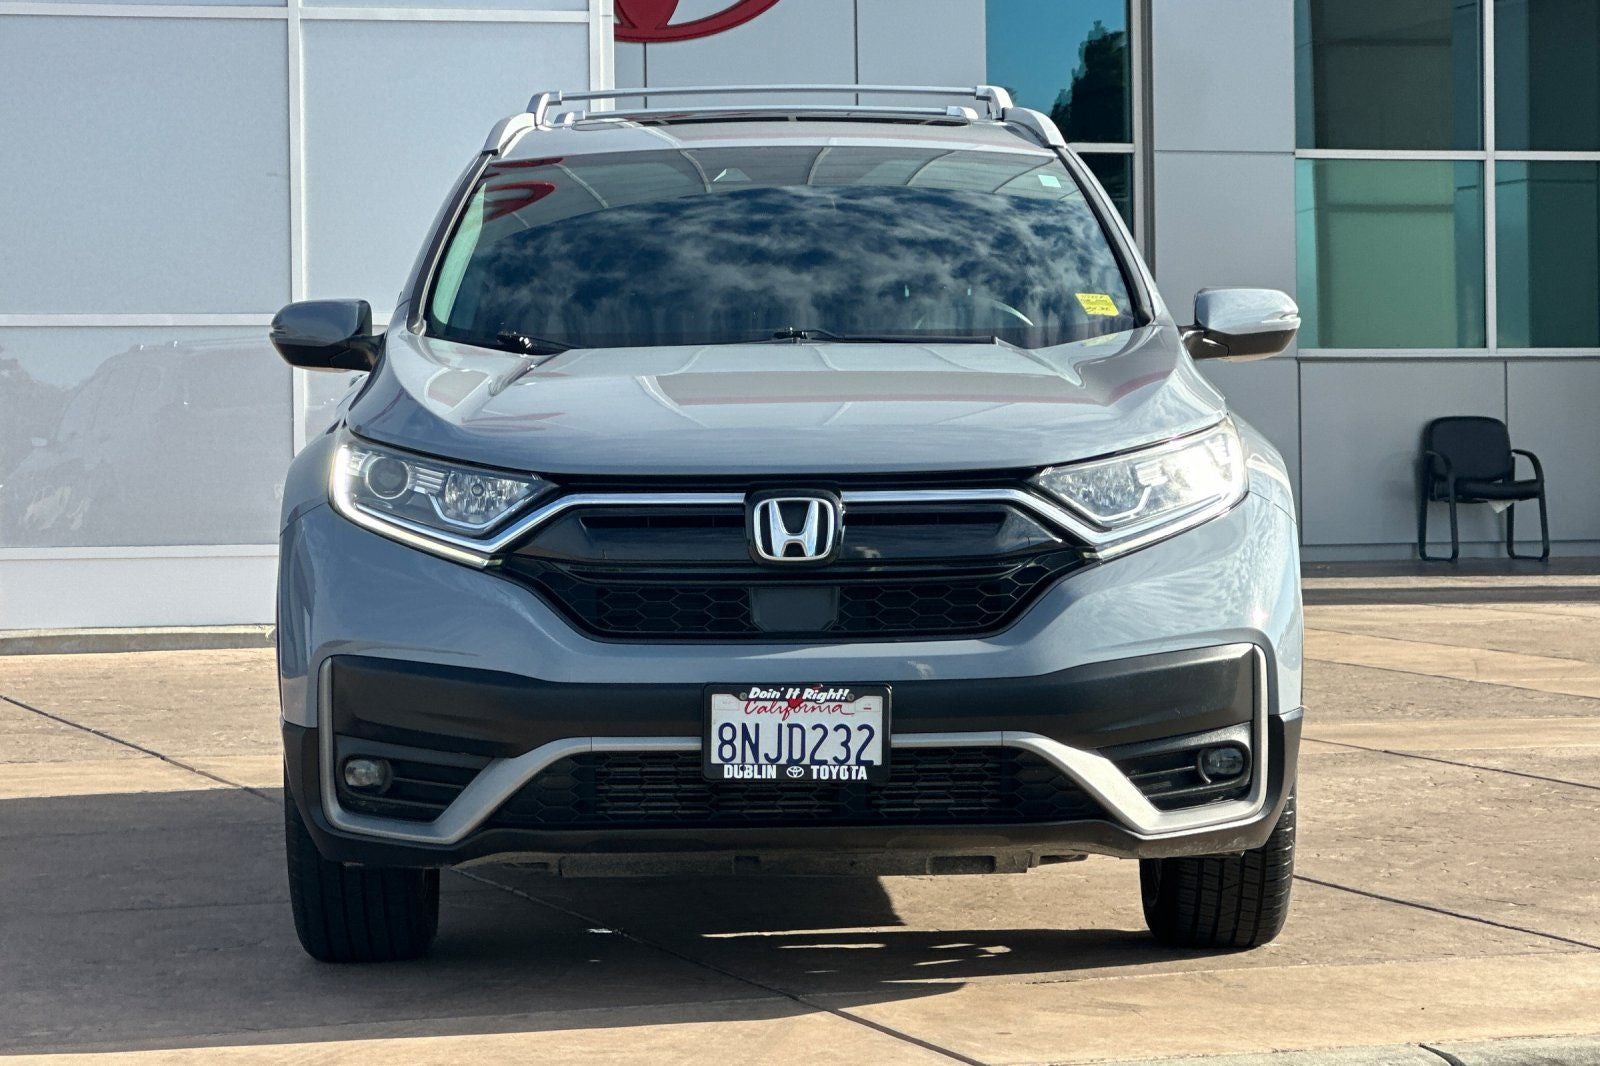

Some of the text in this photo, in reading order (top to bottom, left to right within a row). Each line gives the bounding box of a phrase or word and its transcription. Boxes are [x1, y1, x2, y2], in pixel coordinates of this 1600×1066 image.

[786, 687, 800, 699] It
[802, 687, 850, 704] Right!
[744, 699, 855, 721] California
[718, 722, 874, 765] 8NJD232
[723, 764, 868, 780] DUBLIN TOYOTA
